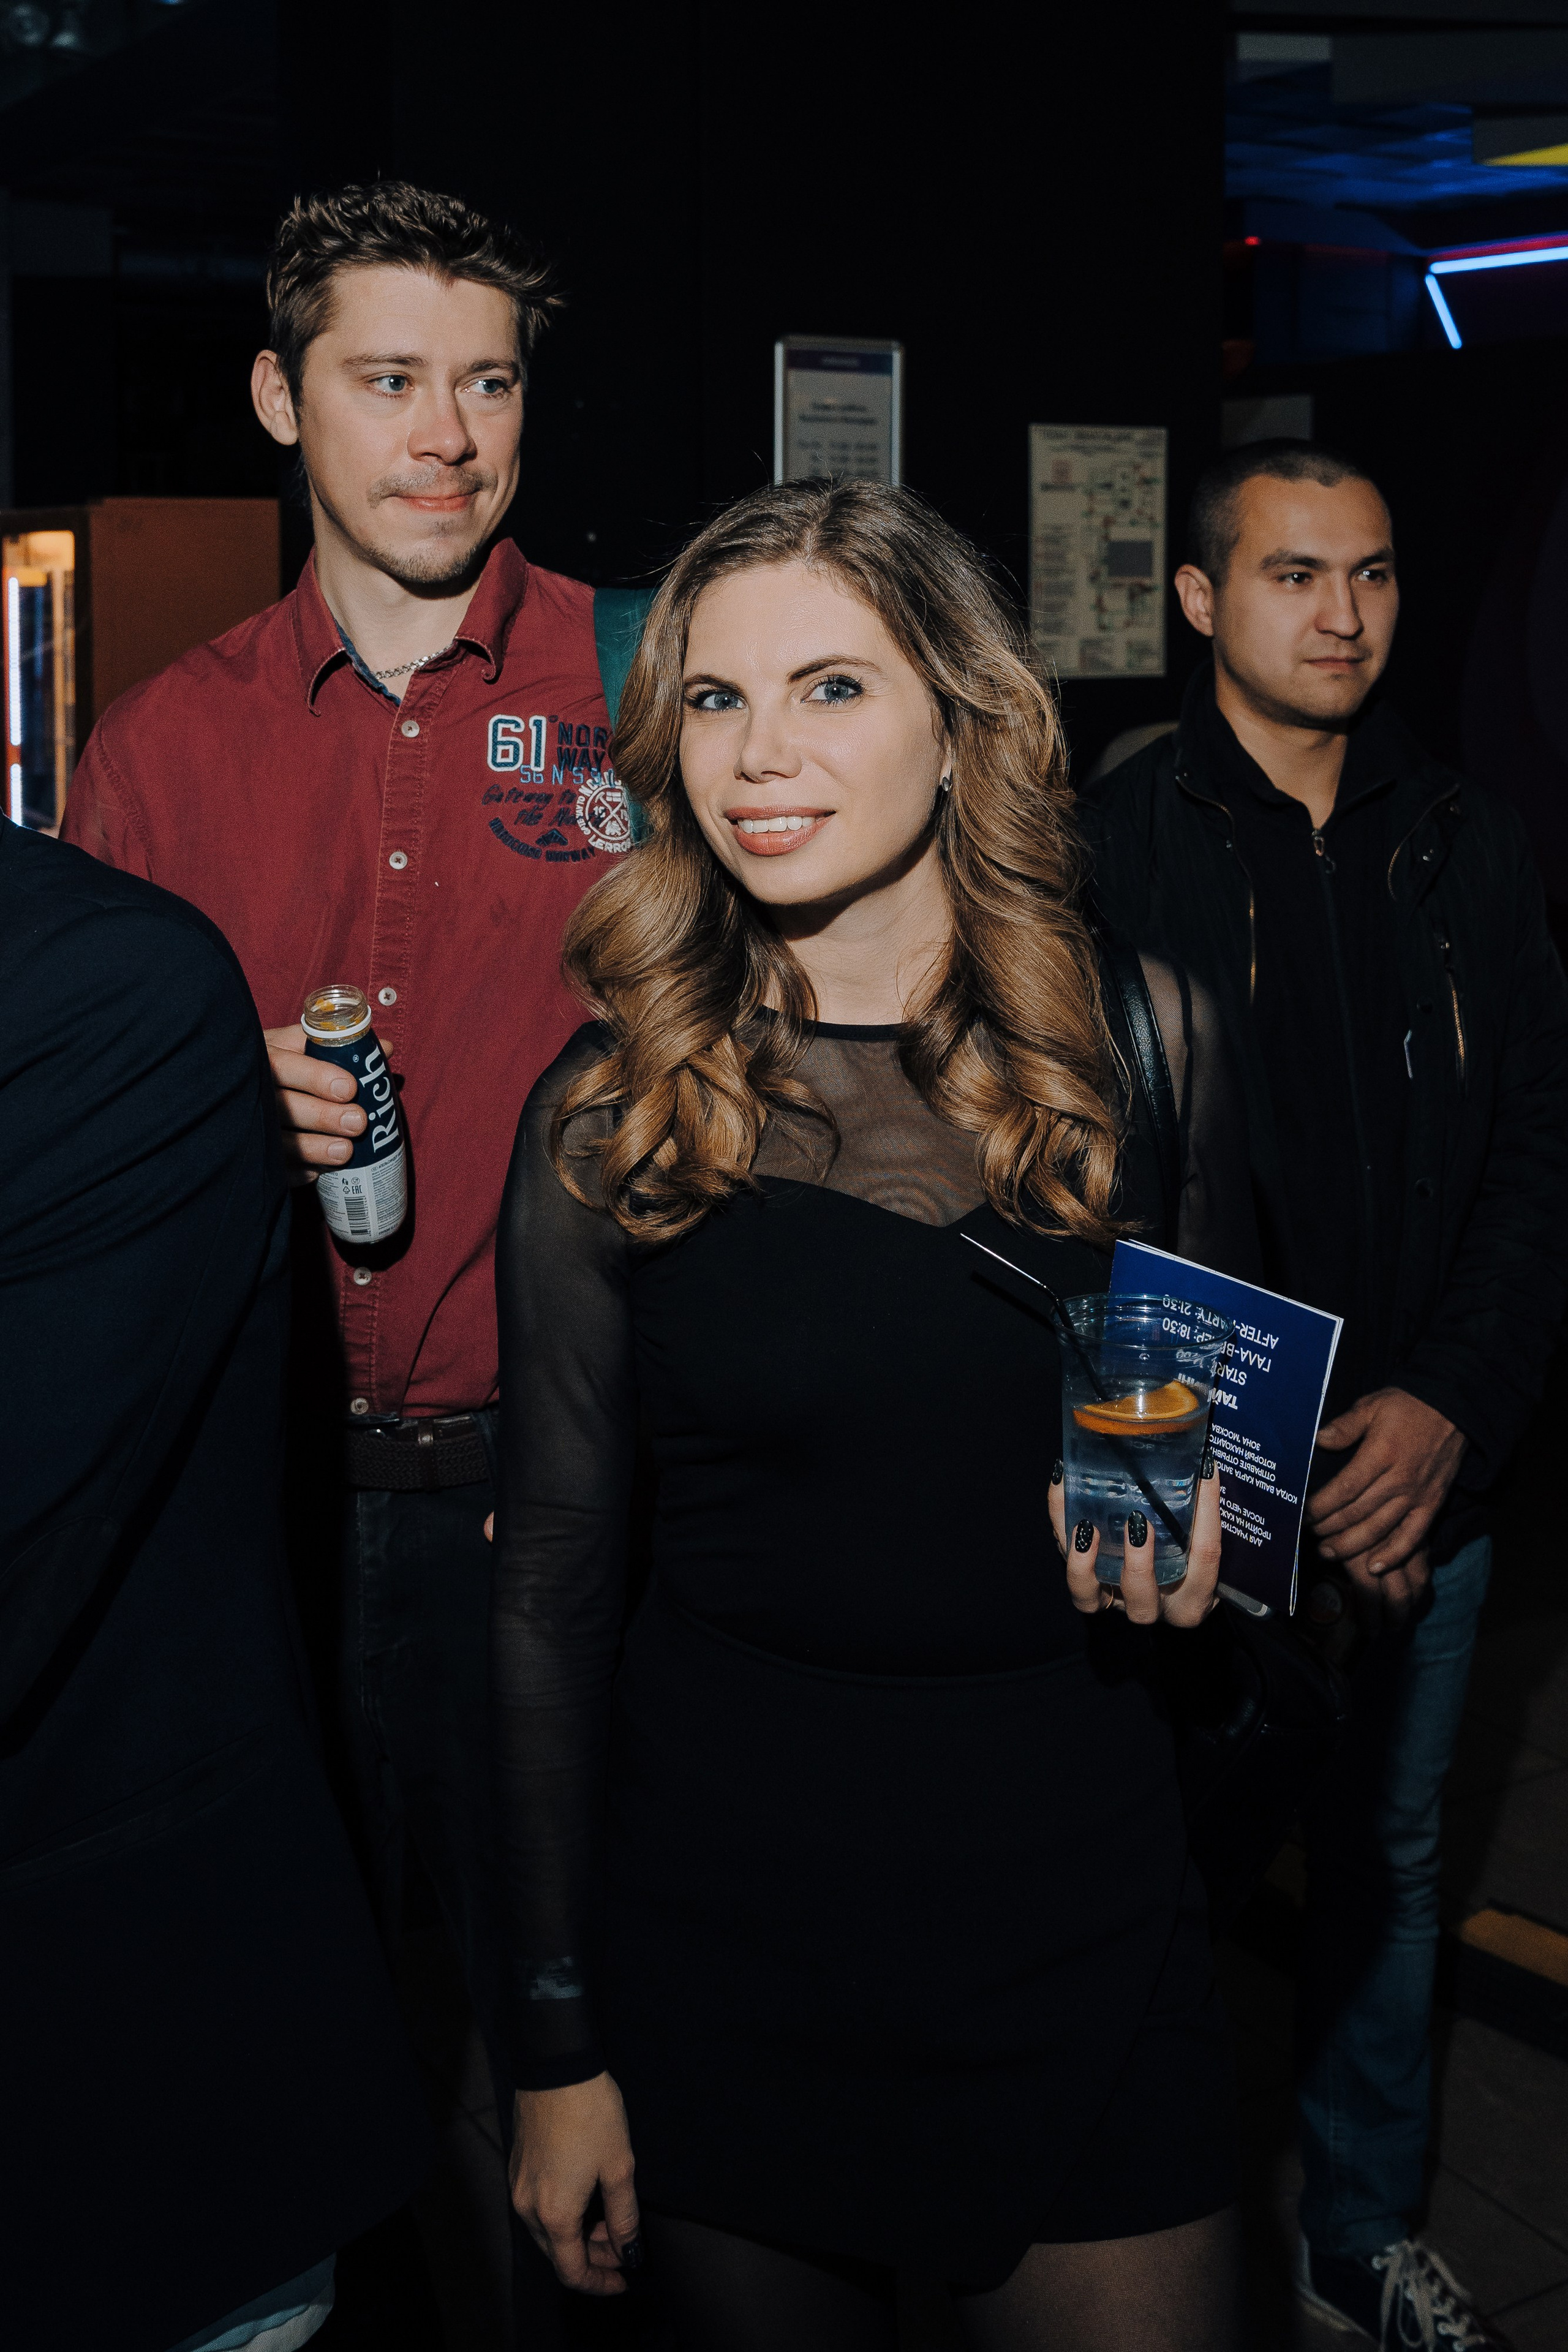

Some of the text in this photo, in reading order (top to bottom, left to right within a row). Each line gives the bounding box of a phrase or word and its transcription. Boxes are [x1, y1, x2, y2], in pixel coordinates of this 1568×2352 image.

[558, 722, 607, 748] NOR
[557, 747, 605, 772] WAY
[481, 784, 576, 811] Gateway to
[358, 1043, 400, 1153] Rich
[1163, 1294, 1192, 1316] 21:30
[1163, 1317, 1191, 1340] 18:30
[1242, 1436, 1261, 1451] ЗОНА
[1245, 1450, 1276, 1471] КОТОРЫЙ
[1235, 1469, 1254, 1485] КАРТА
[1240, 1462, 1276, 1482] ОТПРАВЬТЕ
[1256, 1479, 1275, 1496] ВАША
[1275, 1487, 1298, 1504] КОГДА
[1226, 1500, 1242, 1514] ЧЕГО
[1242, 1507, 1265, 1525] ПОСЛЕ
[1235, 1515, 1245, 1527] НА
[1221, 1520, 1263, 1547] ДЛЯ УЧАСТИЯ
[1245, 1523, 1272, 1540] ПРОЙТИ
